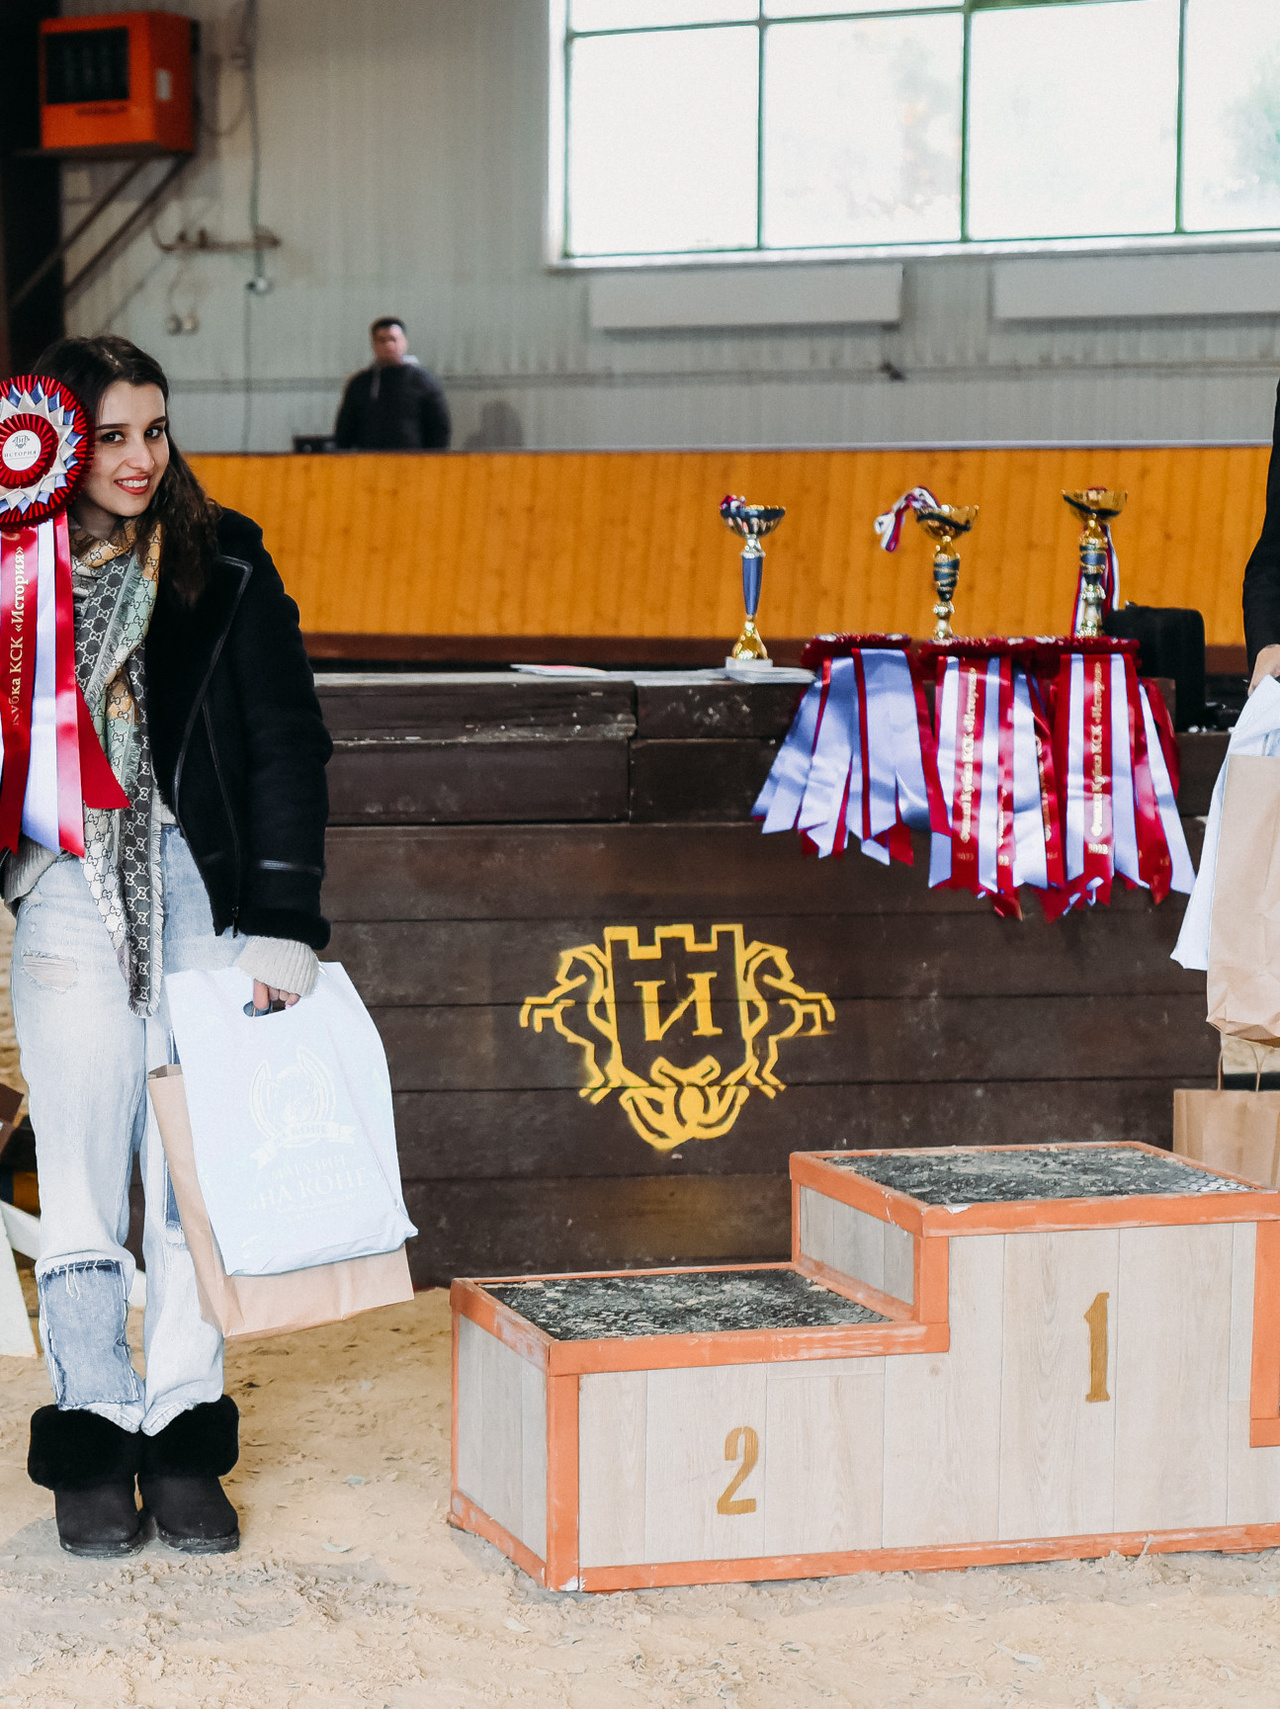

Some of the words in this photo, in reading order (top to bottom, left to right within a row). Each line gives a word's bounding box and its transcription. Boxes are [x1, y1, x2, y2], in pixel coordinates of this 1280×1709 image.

[11, 546, 29, 632] «История»
[9, 636, 23, 674] КСК
[1091, 724, 1102, 754] КСК
[633, 971, 723, 1041] И
[1084, 1292, 1111, 1403] 1
[716, 1426, 760, 1516] 2
